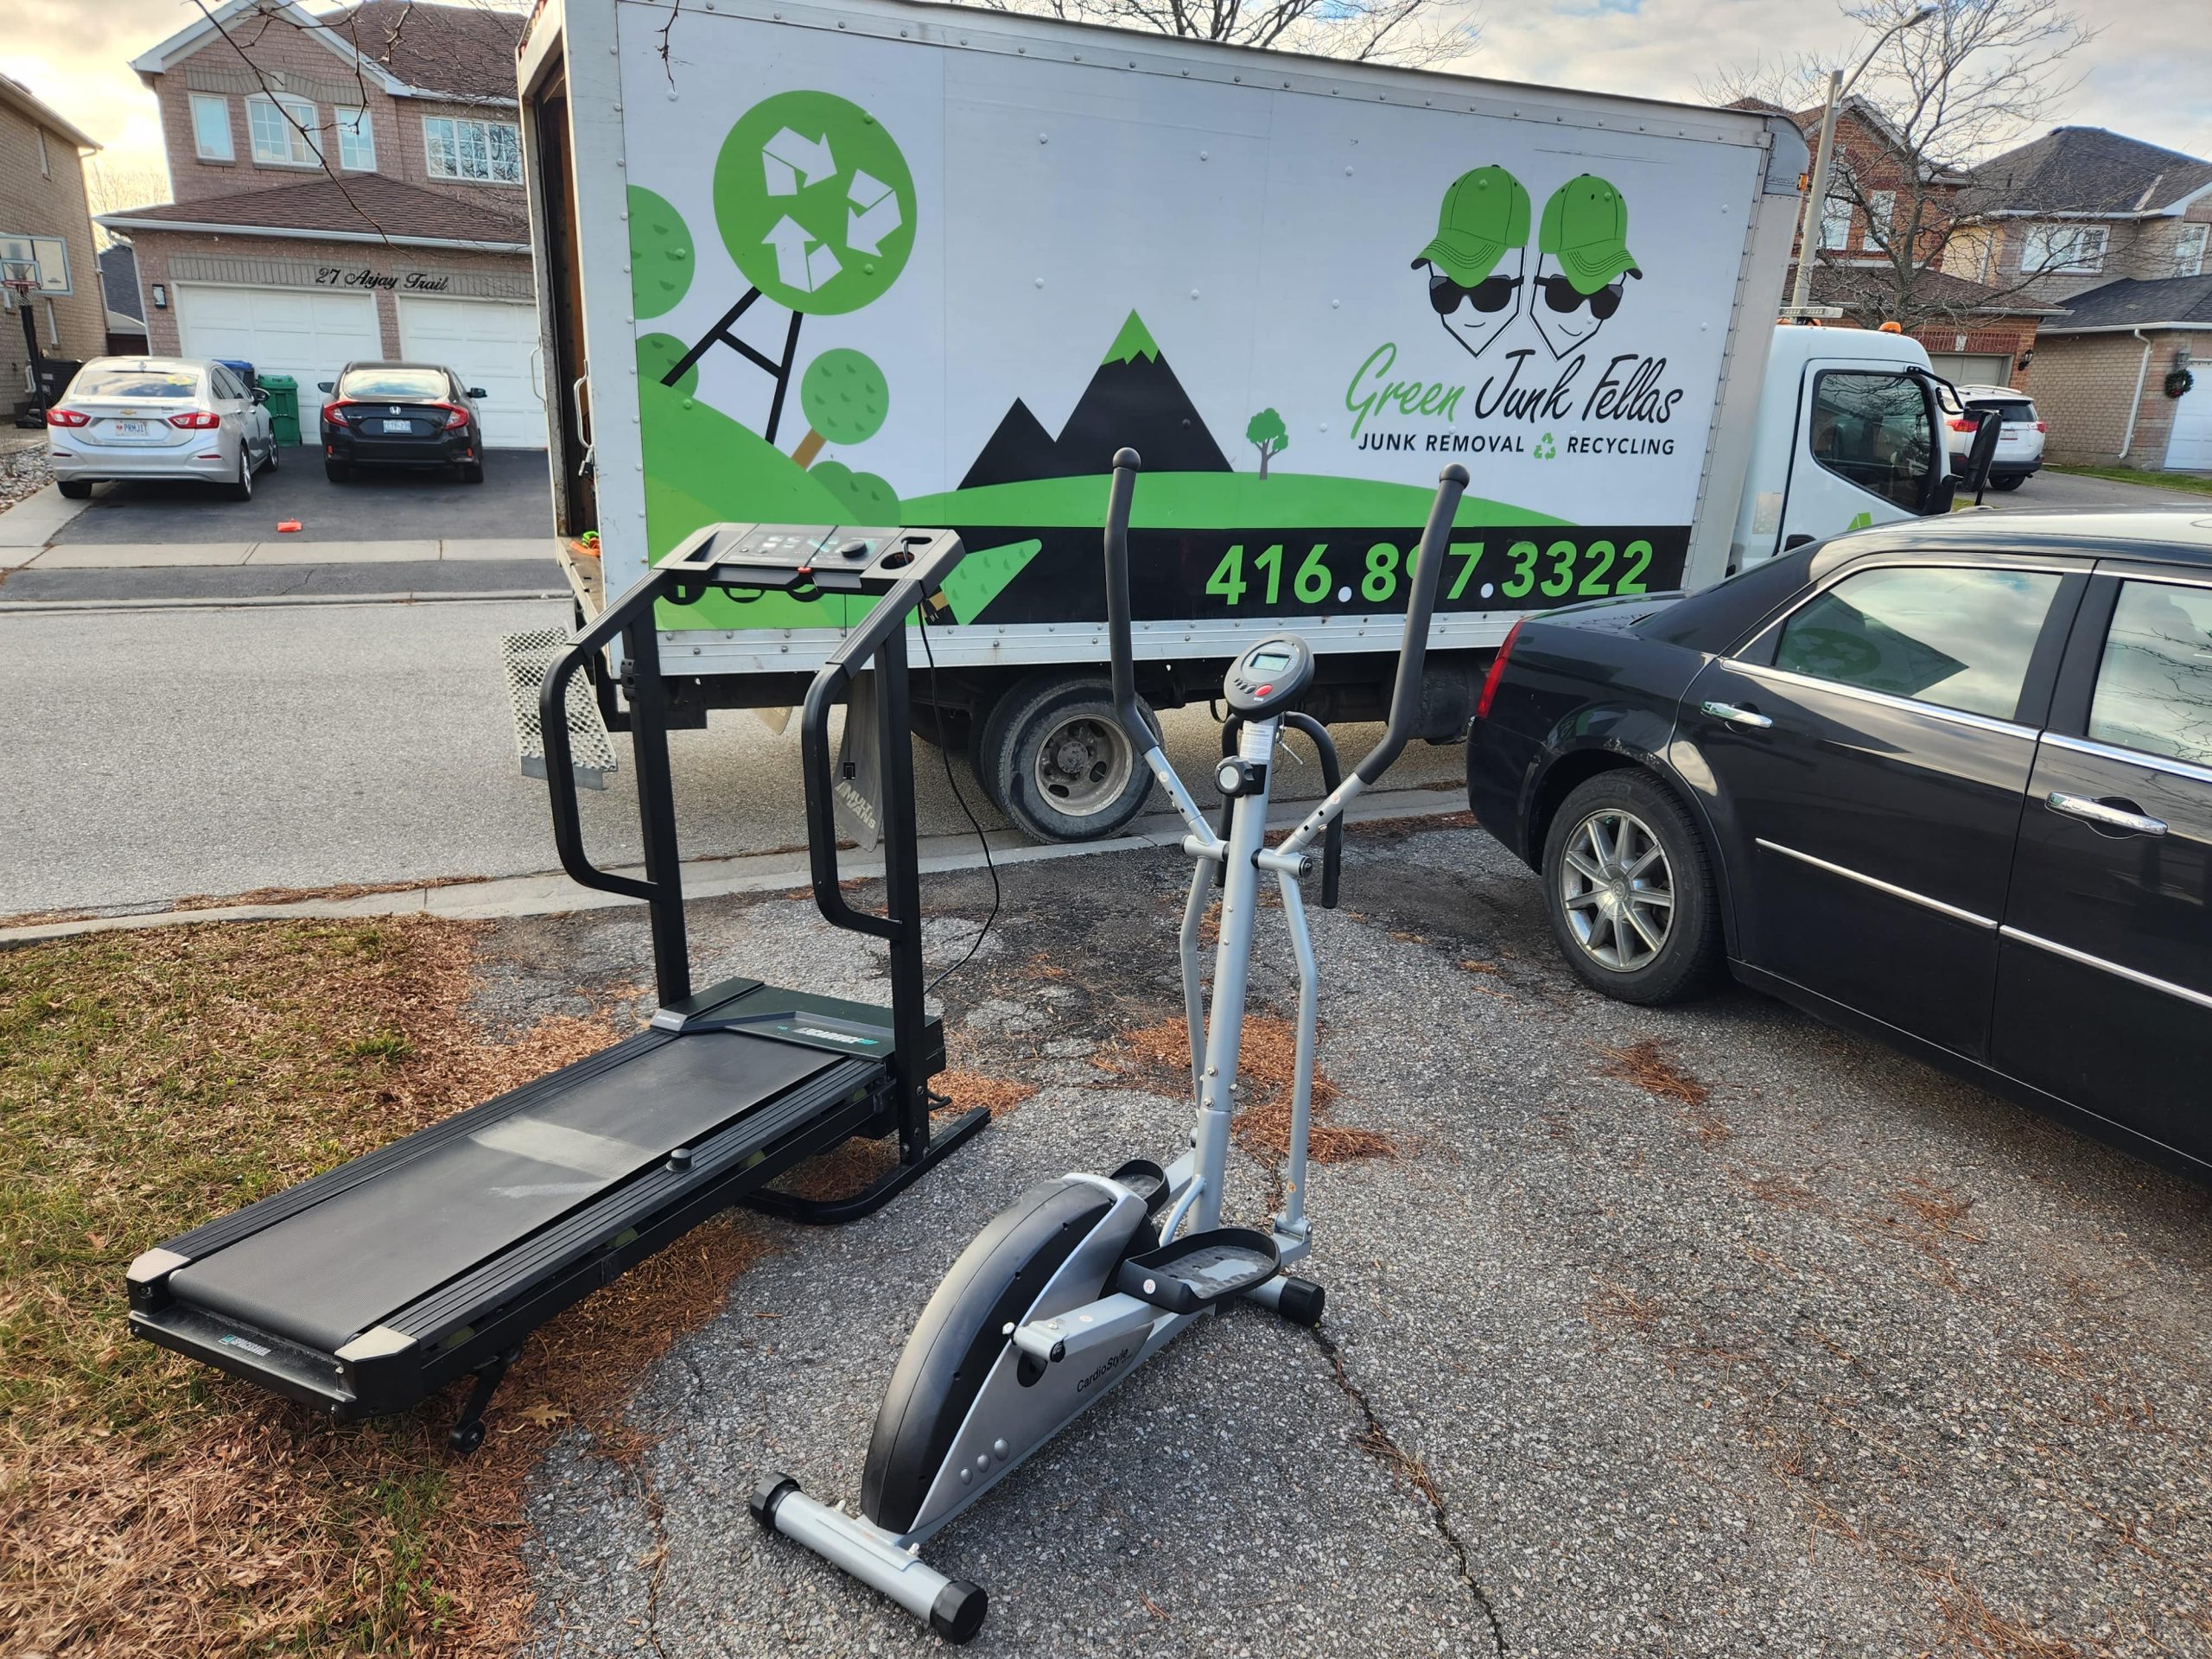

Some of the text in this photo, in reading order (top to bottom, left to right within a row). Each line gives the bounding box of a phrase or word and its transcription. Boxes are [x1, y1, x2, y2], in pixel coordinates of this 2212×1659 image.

[315, 267, 448, 291] 27 Arjay Trail
[1345, 341, 1684, 440] Green Junk Fellas
[1358, 432, 1675, 455] JUNK REMOVAL RECYCLING
[1077, 1348, 1128, 1393] CardioStyle
